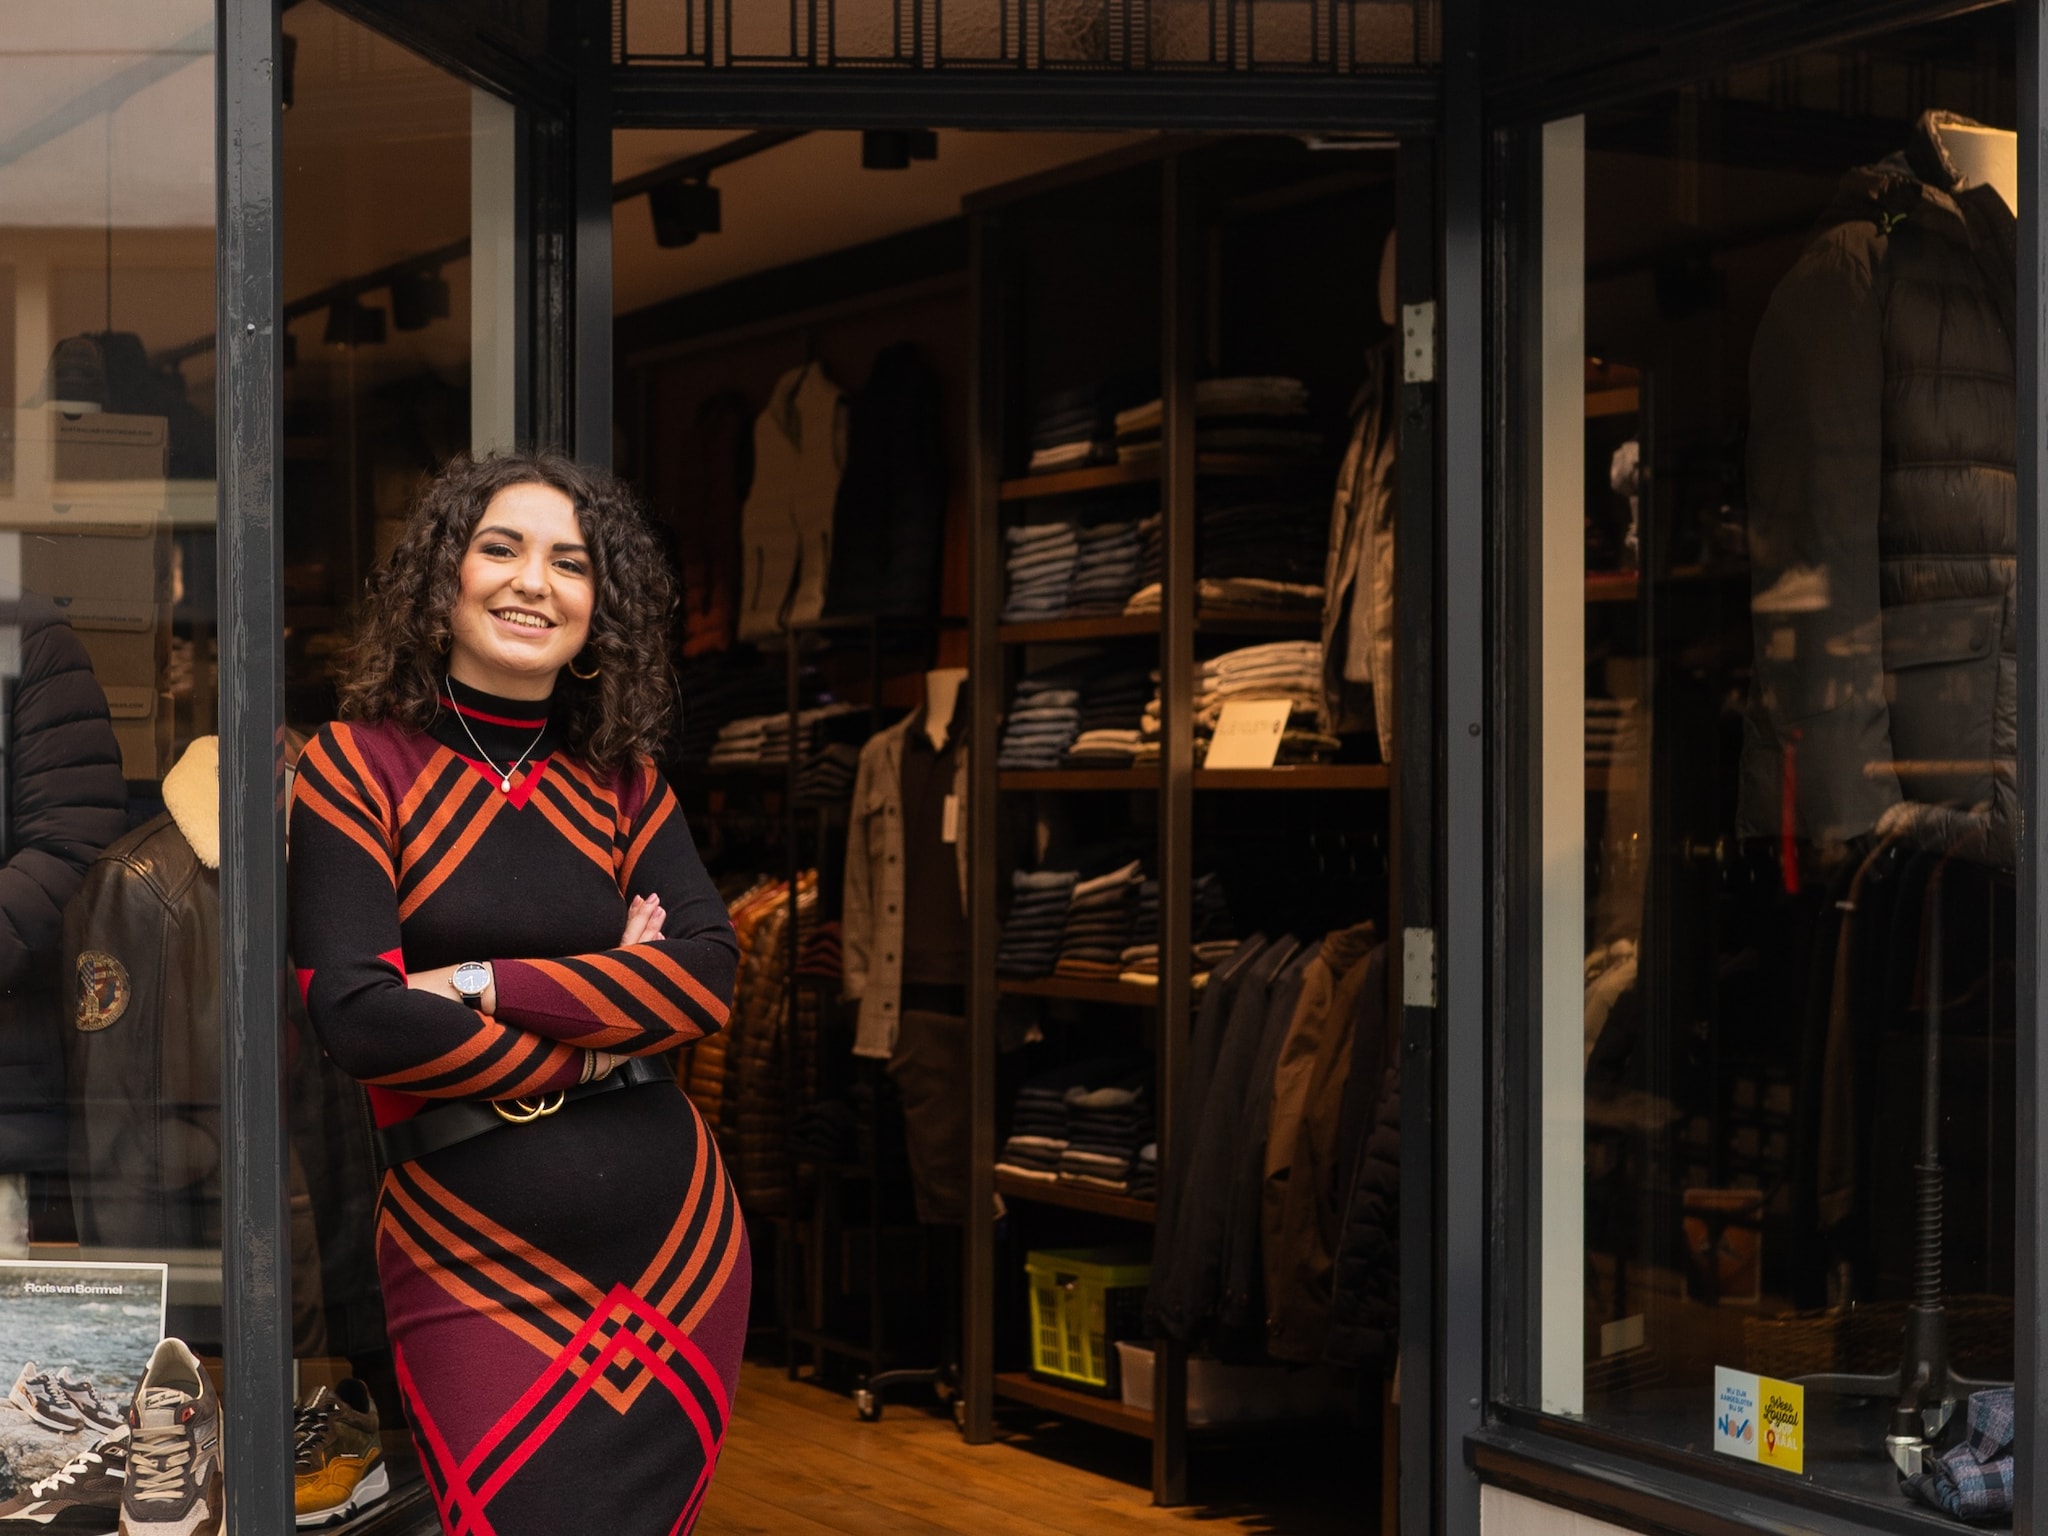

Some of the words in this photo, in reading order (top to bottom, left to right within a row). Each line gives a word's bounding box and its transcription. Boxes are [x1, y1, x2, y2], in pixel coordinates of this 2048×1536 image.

[24, 1283, 57, 1293] Floris
[57, 1284, 75, 1294] van
[75, 1284, 123, 1295] Bommel
[1770, 1395, 1794, 1412] Wees
[1763, 1404, 1799, 1427] Loyaal
